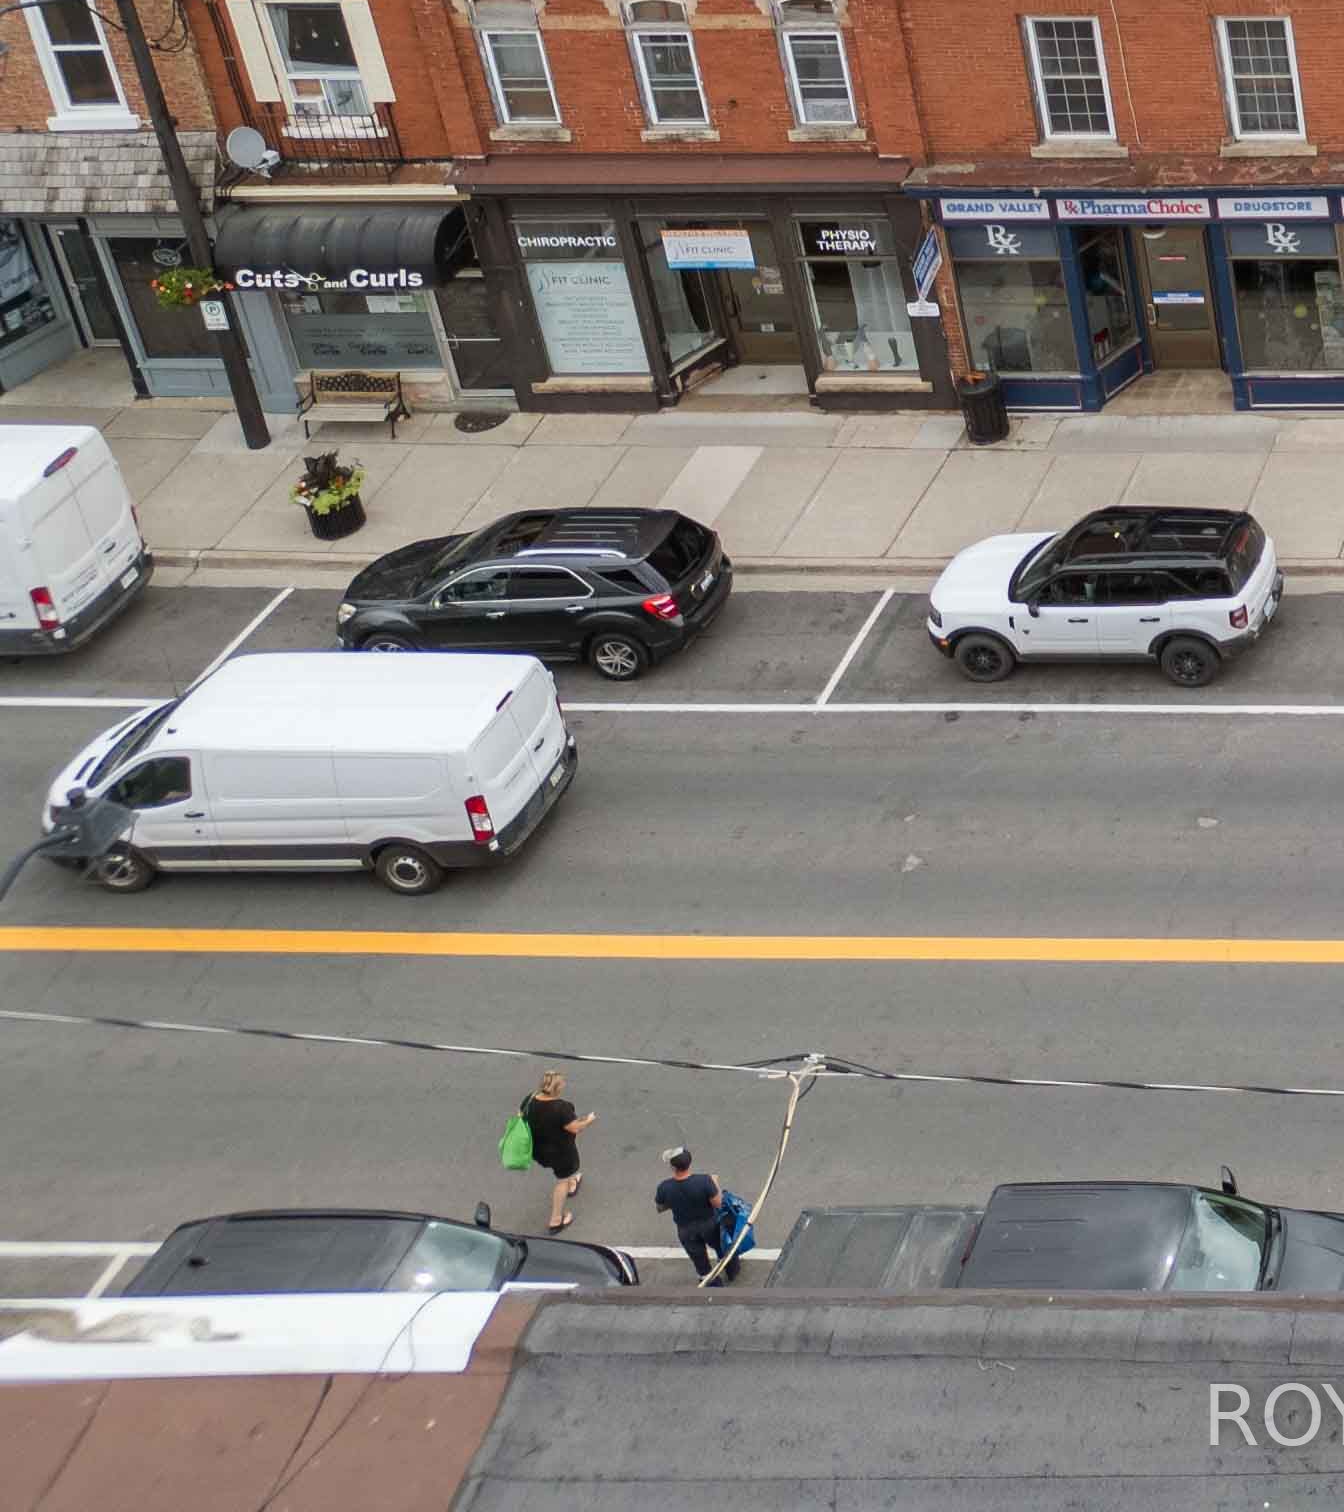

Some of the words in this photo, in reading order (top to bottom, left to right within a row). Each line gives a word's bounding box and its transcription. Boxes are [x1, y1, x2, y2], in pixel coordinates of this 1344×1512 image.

[946, 203, 994, 213] GRAND
[999, 202, 1042, 213] VALLEY
[1079, 200, 1203, 215] PharmaChoice
[1233, 201, 1312, 212] DRUGSTORE
[821, 230, 870, 240] PHYSIO
[517, 236, 616, 247] CHIROPRACTIC
[817, 240, 876, 251] THERAPY
[702, 246, 735, 254] CLINIC
[235, 269, 300, 288] Cuts
[324, 279, 348, 289] and
[350, 269, 424, 288] Curls
[570, 275, 612, 286] CLINIC
